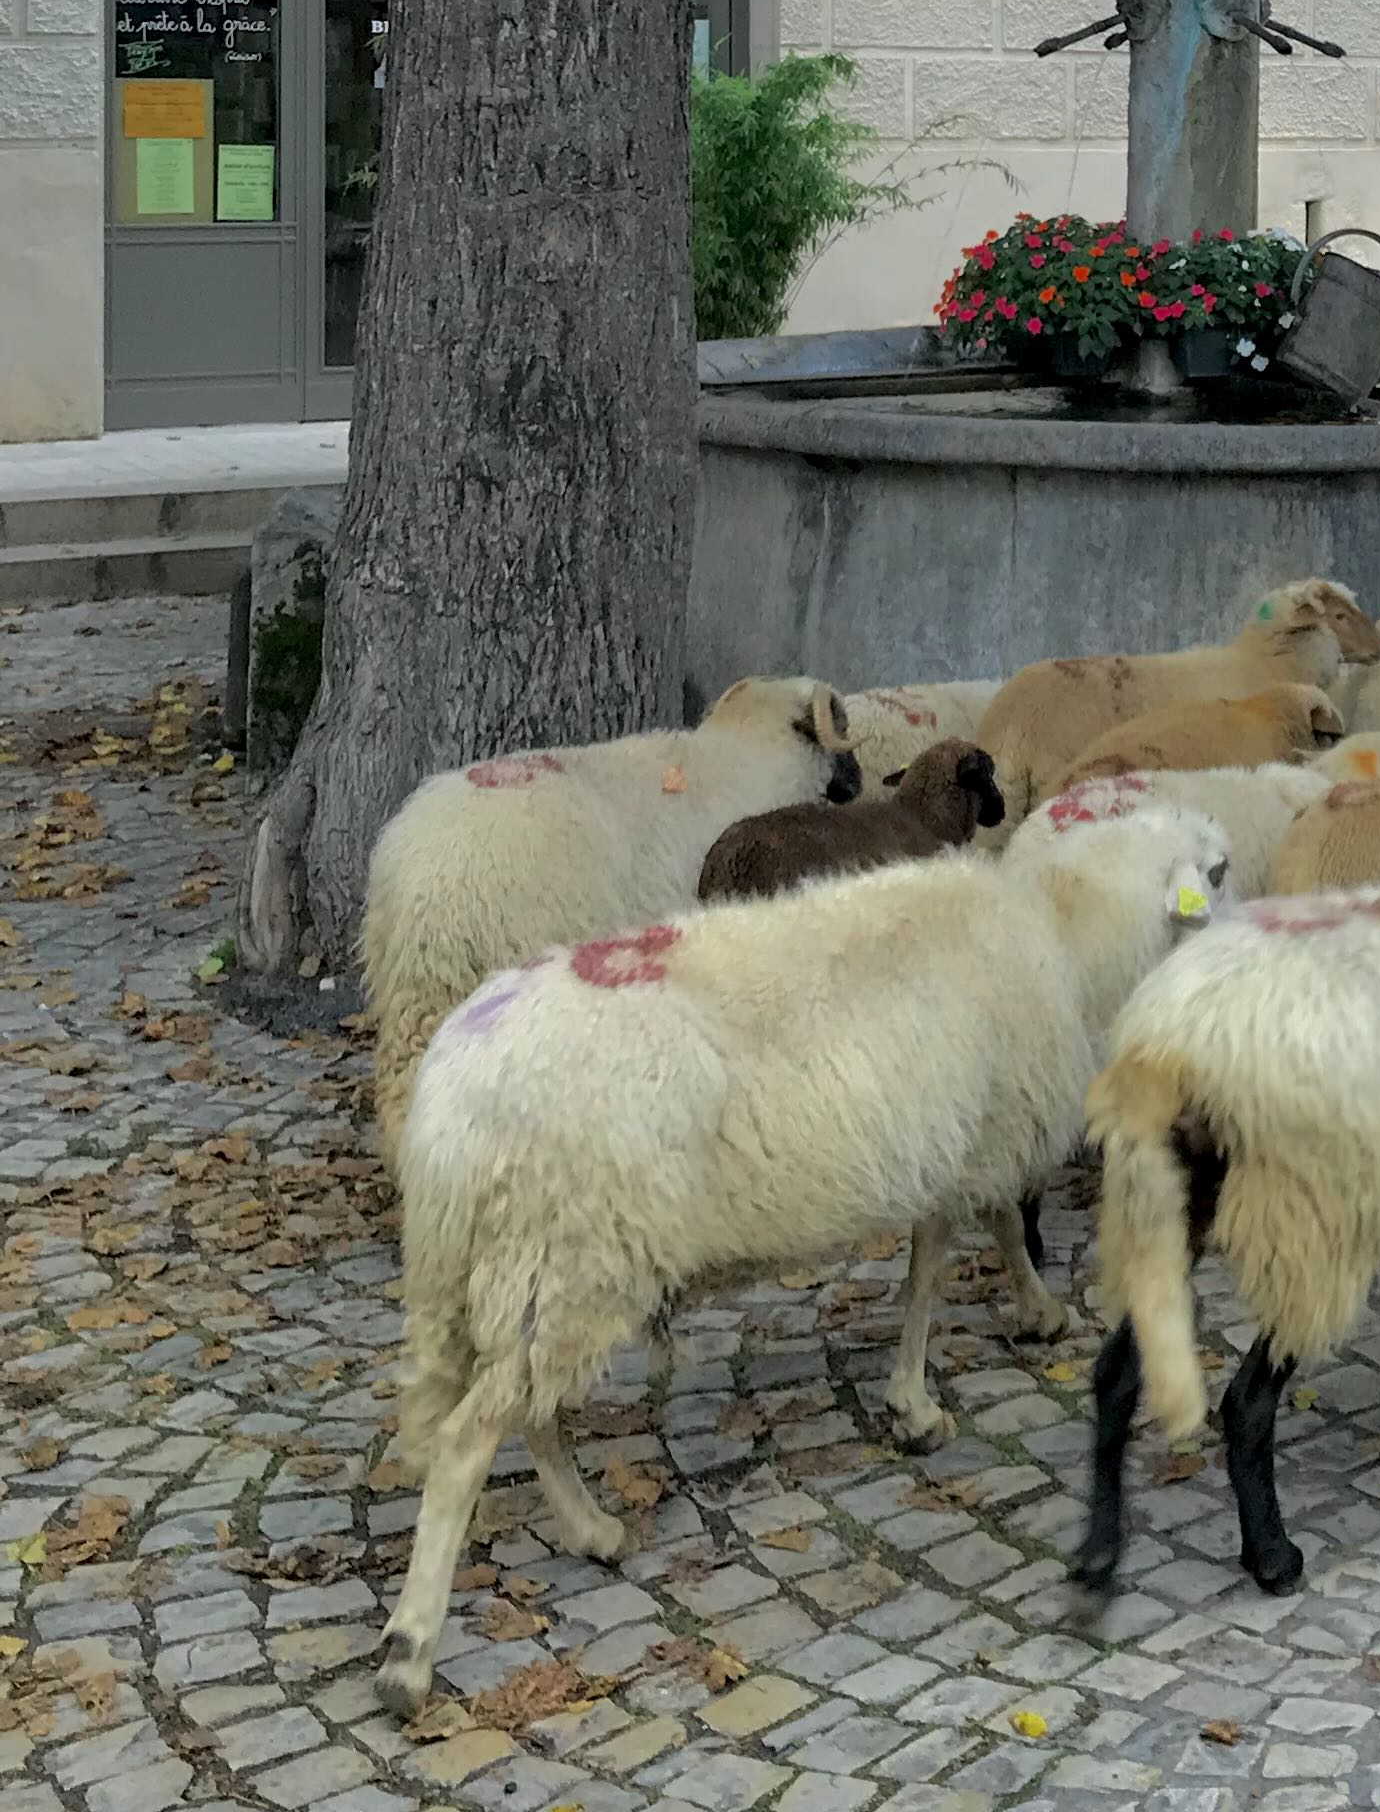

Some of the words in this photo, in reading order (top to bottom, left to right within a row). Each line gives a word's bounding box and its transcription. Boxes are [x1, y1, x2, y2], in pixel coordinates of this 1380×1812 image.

[116, 11, 136, 33] et
[135, 10, 178, 42] prête
[196, 7, 217, 33] la
